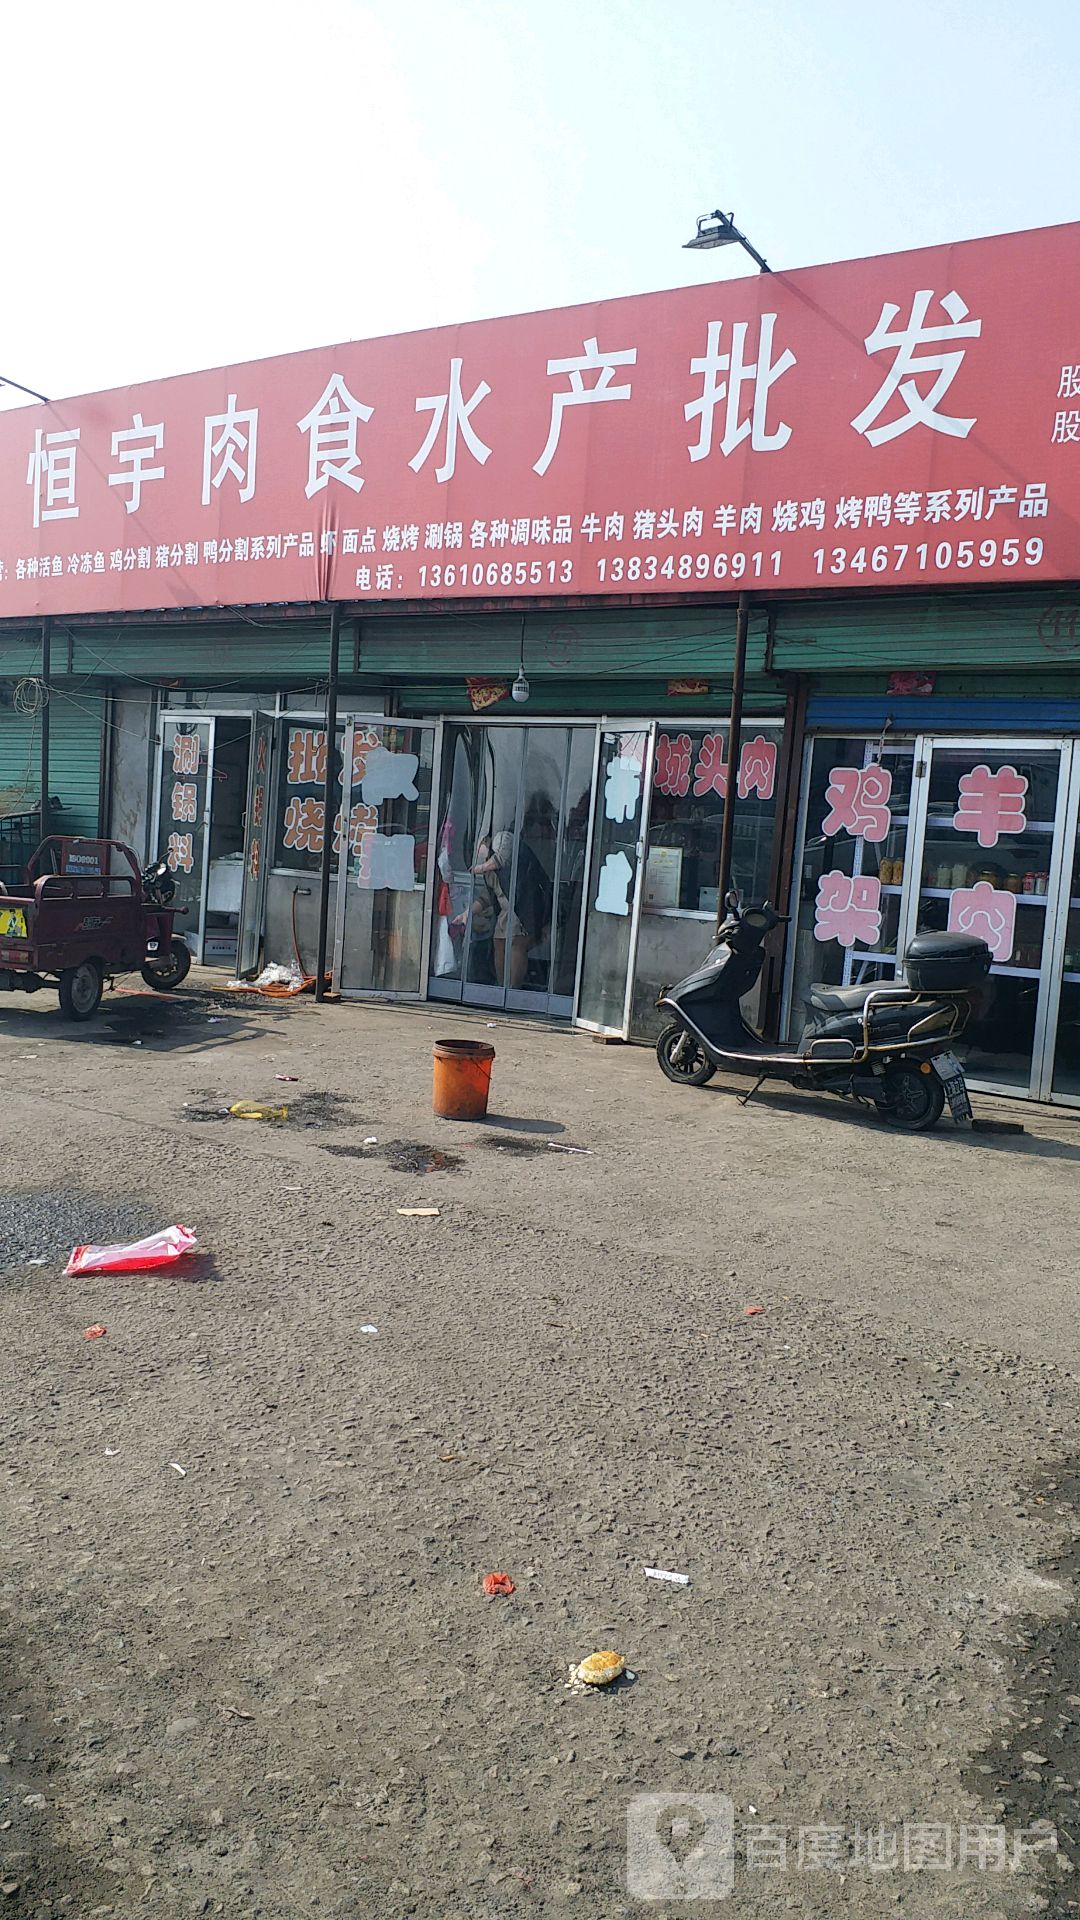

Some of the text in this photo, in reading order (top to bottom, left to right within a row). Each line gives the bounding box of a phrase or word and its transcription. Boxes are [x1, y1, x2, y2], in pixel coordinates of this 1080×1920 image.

[26, 289, 982, 528] 恒宇肉食水产批发
[1050, 410, 1080, 443] 股
[16, 556, 63, 579] 各种活鱼
[68, 551, 105, 575] 冷冻鱼
[109, 546, 152, 572] 鸡分割
[155, 542, 198, 567] 猪分割
[204, 532, 314, 563] 鸭分割系列产品
[343, 527, 376, 554] 面点
[382, 524, 419, 551] 烧烤
[425, 522, 462, 549] 涮锅
[470, 515, 572, 548] 各种调味品
[581, 512, 624, 542] 牛肉
[633, 507, 703, 539] 猪头肉
[713, 503, 762, 536] 羊肉
[772, 498, 825, 532] 烧鸡
[834, 484, 1048, 528] 烤鸭等系列产品
[356, 538, 1043, 590] 电话： 13610685513 13834896911 13467105959
[166, 734, 200, 874] 涮锅料
[814, 763, 893, 948] 鸡架
[946, 764, 1029, 963] 羊肉
